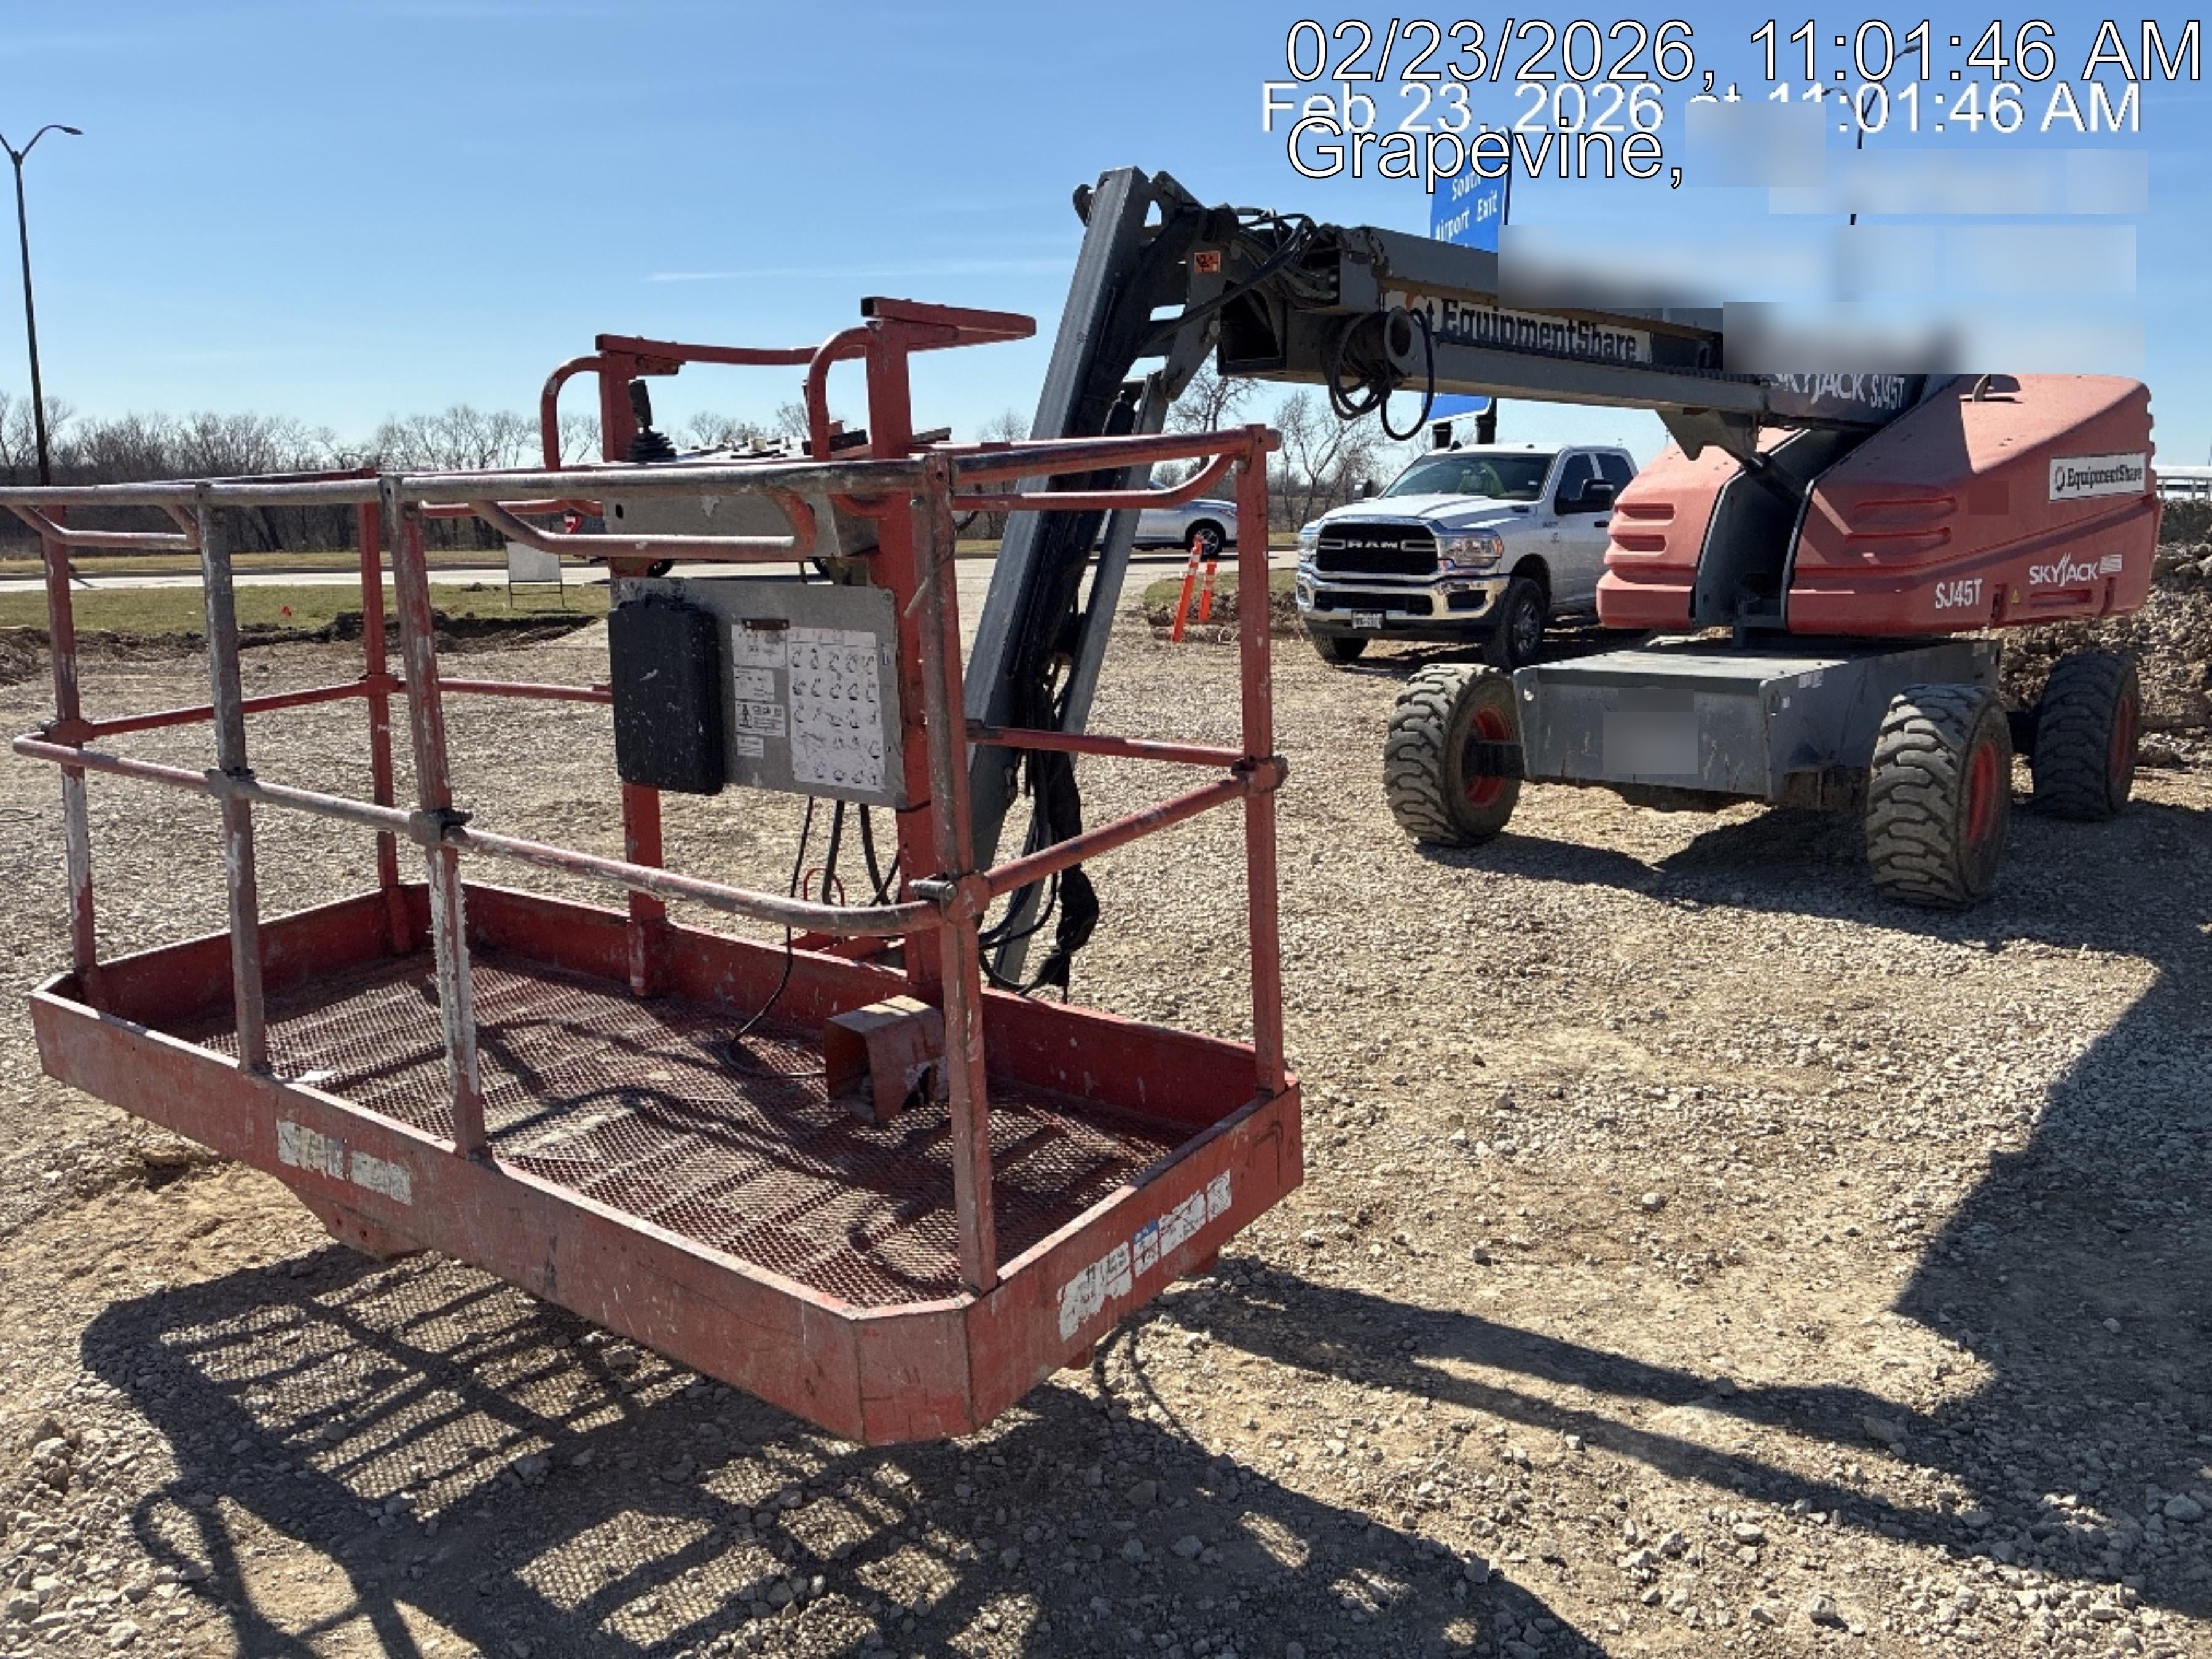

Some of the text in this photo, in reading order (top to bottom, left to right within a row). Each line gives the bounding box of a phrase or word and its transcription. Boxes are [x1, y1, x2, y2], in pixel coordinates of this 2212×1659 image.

[1477, 189, 1498, 222] Exit
[1441, 298, 1637, 361] EquipmentShare
[2066, 464, 2143, 491] EquipmentShare
[1347, 539, 1398, 549] RAM
[1935, 578, 1983, 609] SJ45T
[2029, 553, 2098, 587] SKYJACK
